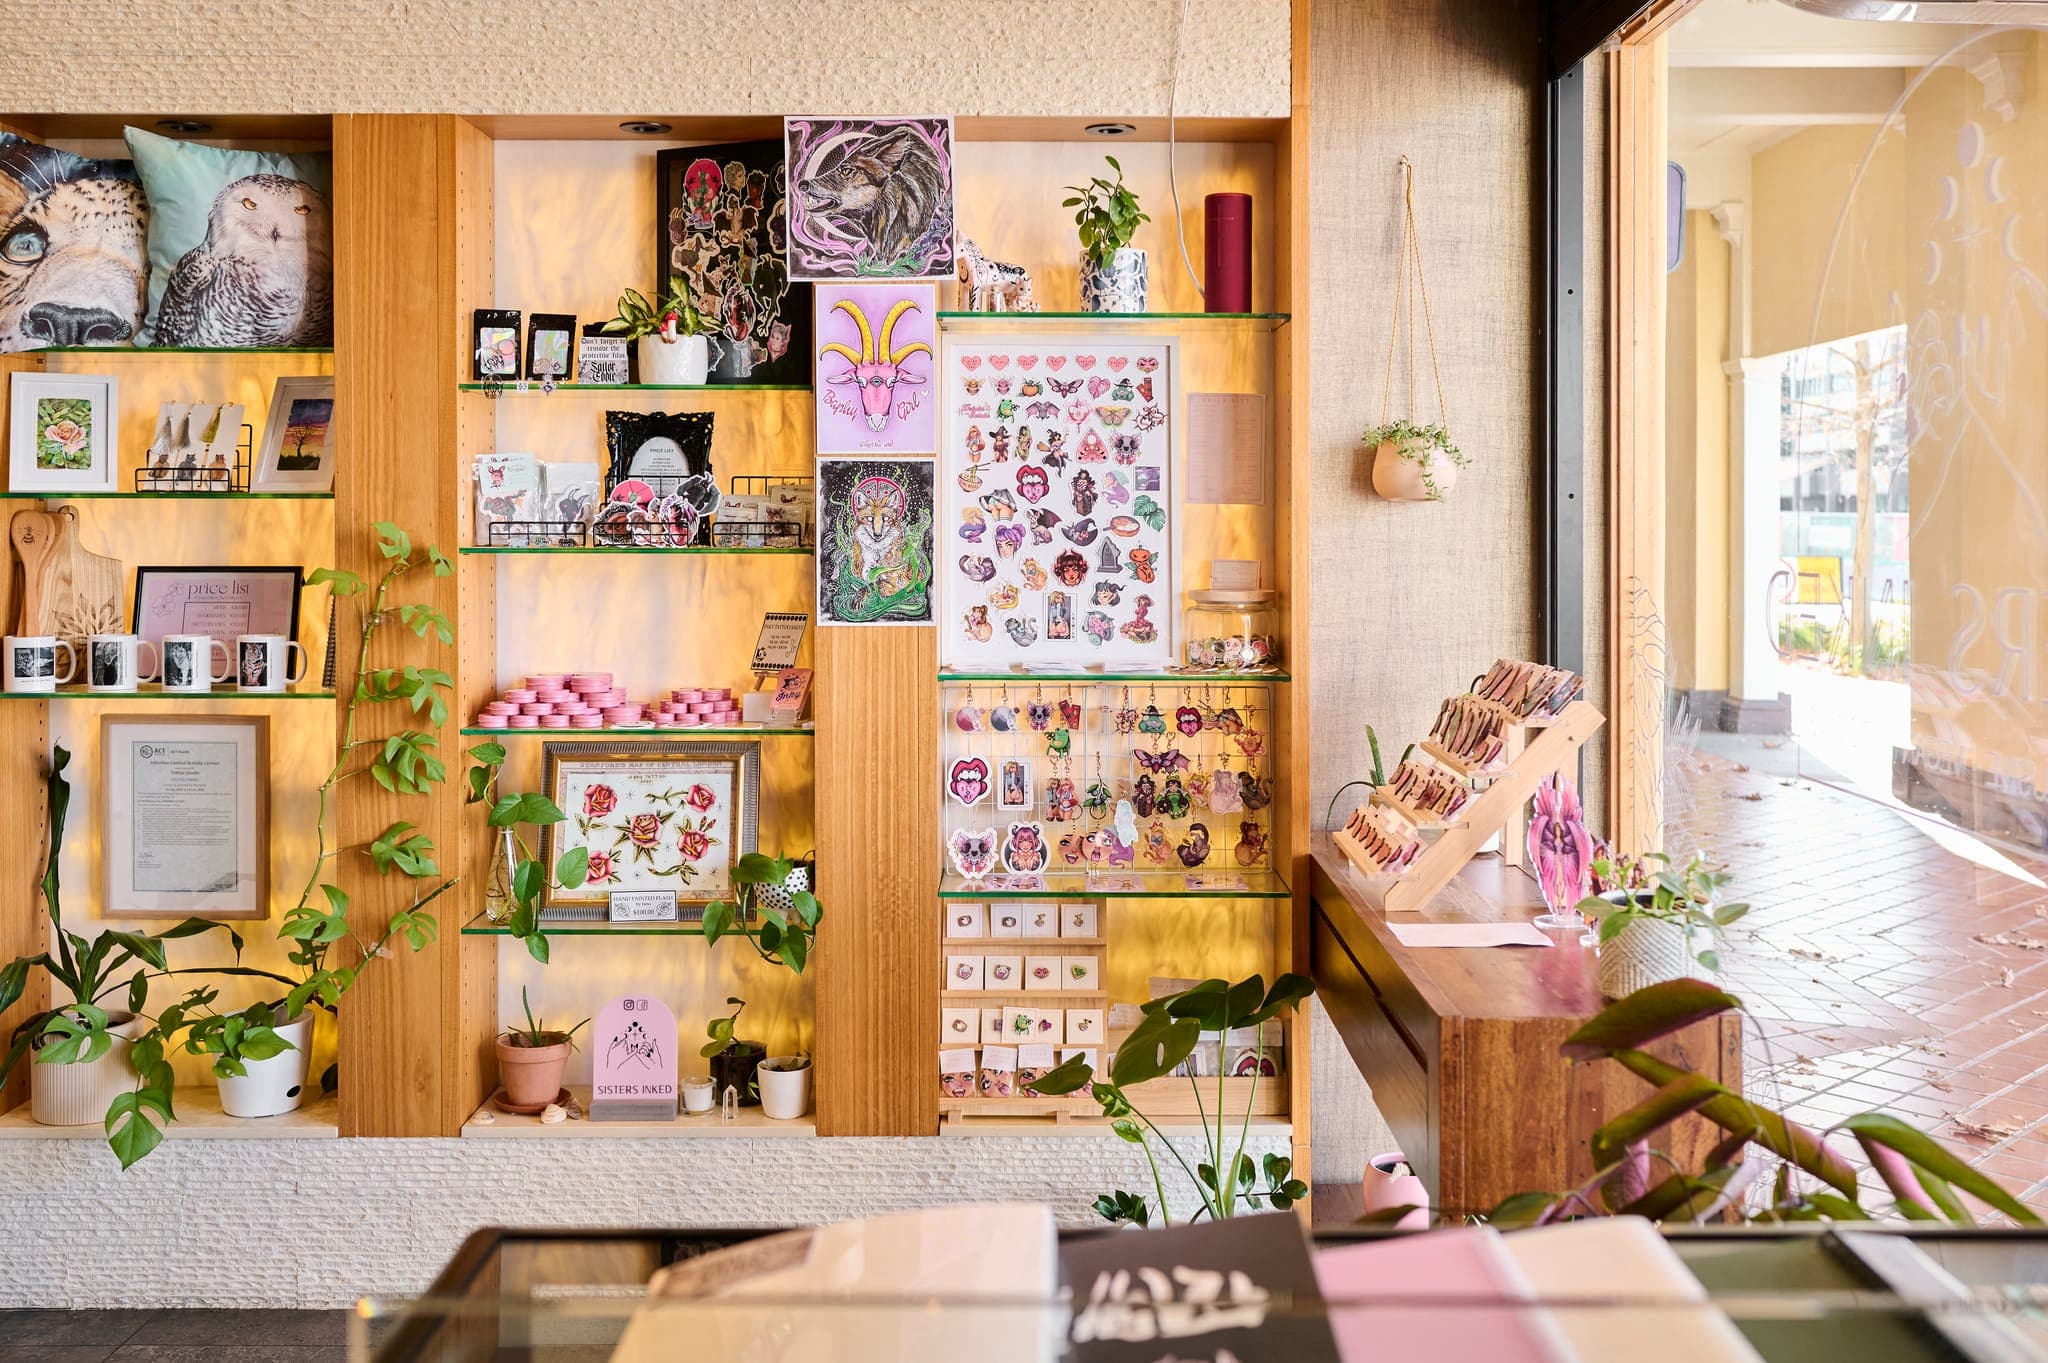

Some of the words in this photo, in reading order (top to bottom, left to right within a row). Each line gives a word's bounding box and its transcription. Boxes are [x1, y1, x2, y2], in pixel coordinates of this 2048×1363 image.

[823, 388, 858, 422] Baphy
[896, 391, 921, 421] Girl
[188, 582, 228, 600] price
[232, 580, 249, 594] list
[776, 692, 801, 702] Inky
[597, 1084, 638, 1096] SISTERS
[642, 1084, 672, 1095] INKED
